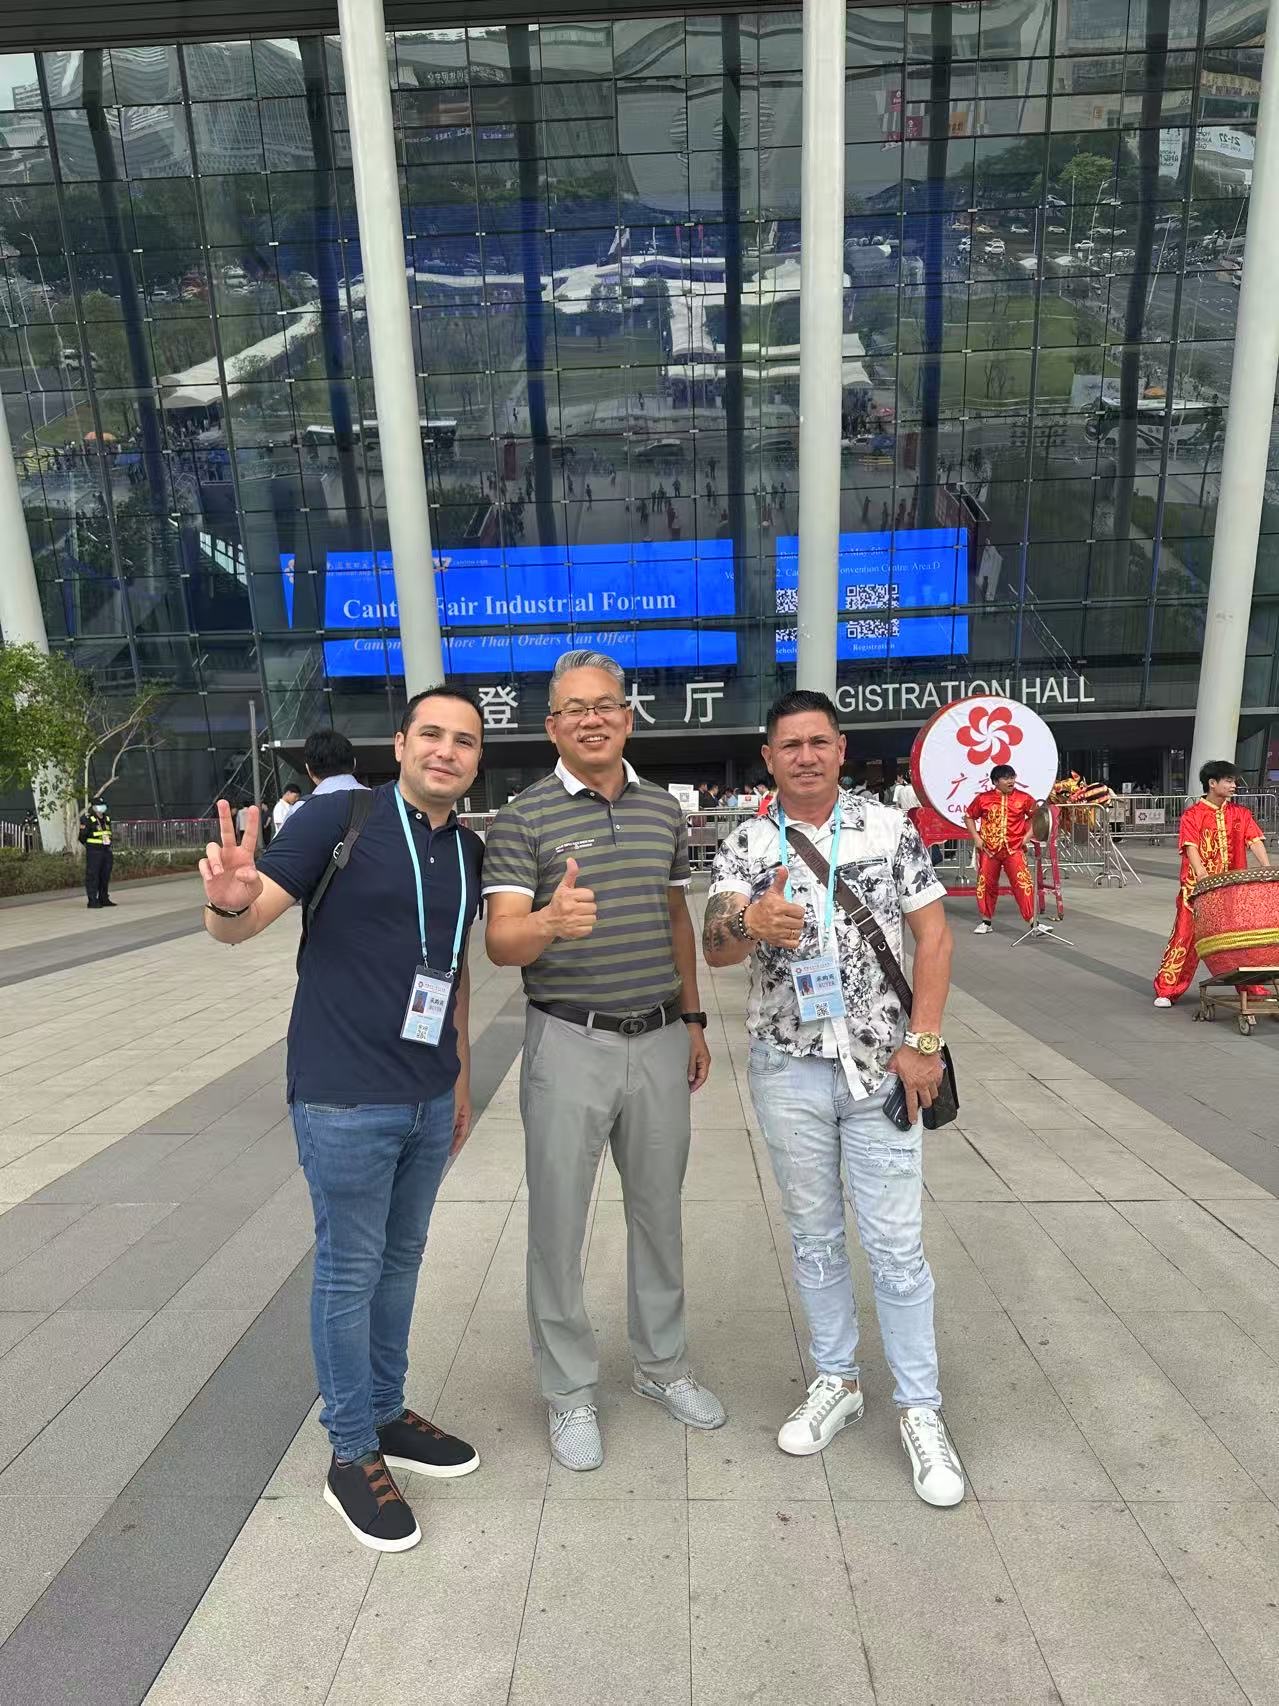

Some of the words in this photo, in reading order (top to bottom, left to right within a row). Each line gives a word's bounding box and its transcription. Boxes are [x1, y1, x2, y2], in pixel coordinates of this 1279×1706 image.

[840, 566, 880, 576] onvention
[343, 598, 398, 619] Cant
[436, 596, 480, 616] Fair
[485, 592, 594, 615] Industrial
[602, 591, 676, 611] Forum
[518, 634, 562, 648] Orders
[566, 633, 592, 645] Can
[853, 643, 895, 652] Registratin
[478, 682, 724, 728] 登大厅
[835, 678, 1011, 713] GISTRATION
[1021, 676, 1095, 704] HALL
